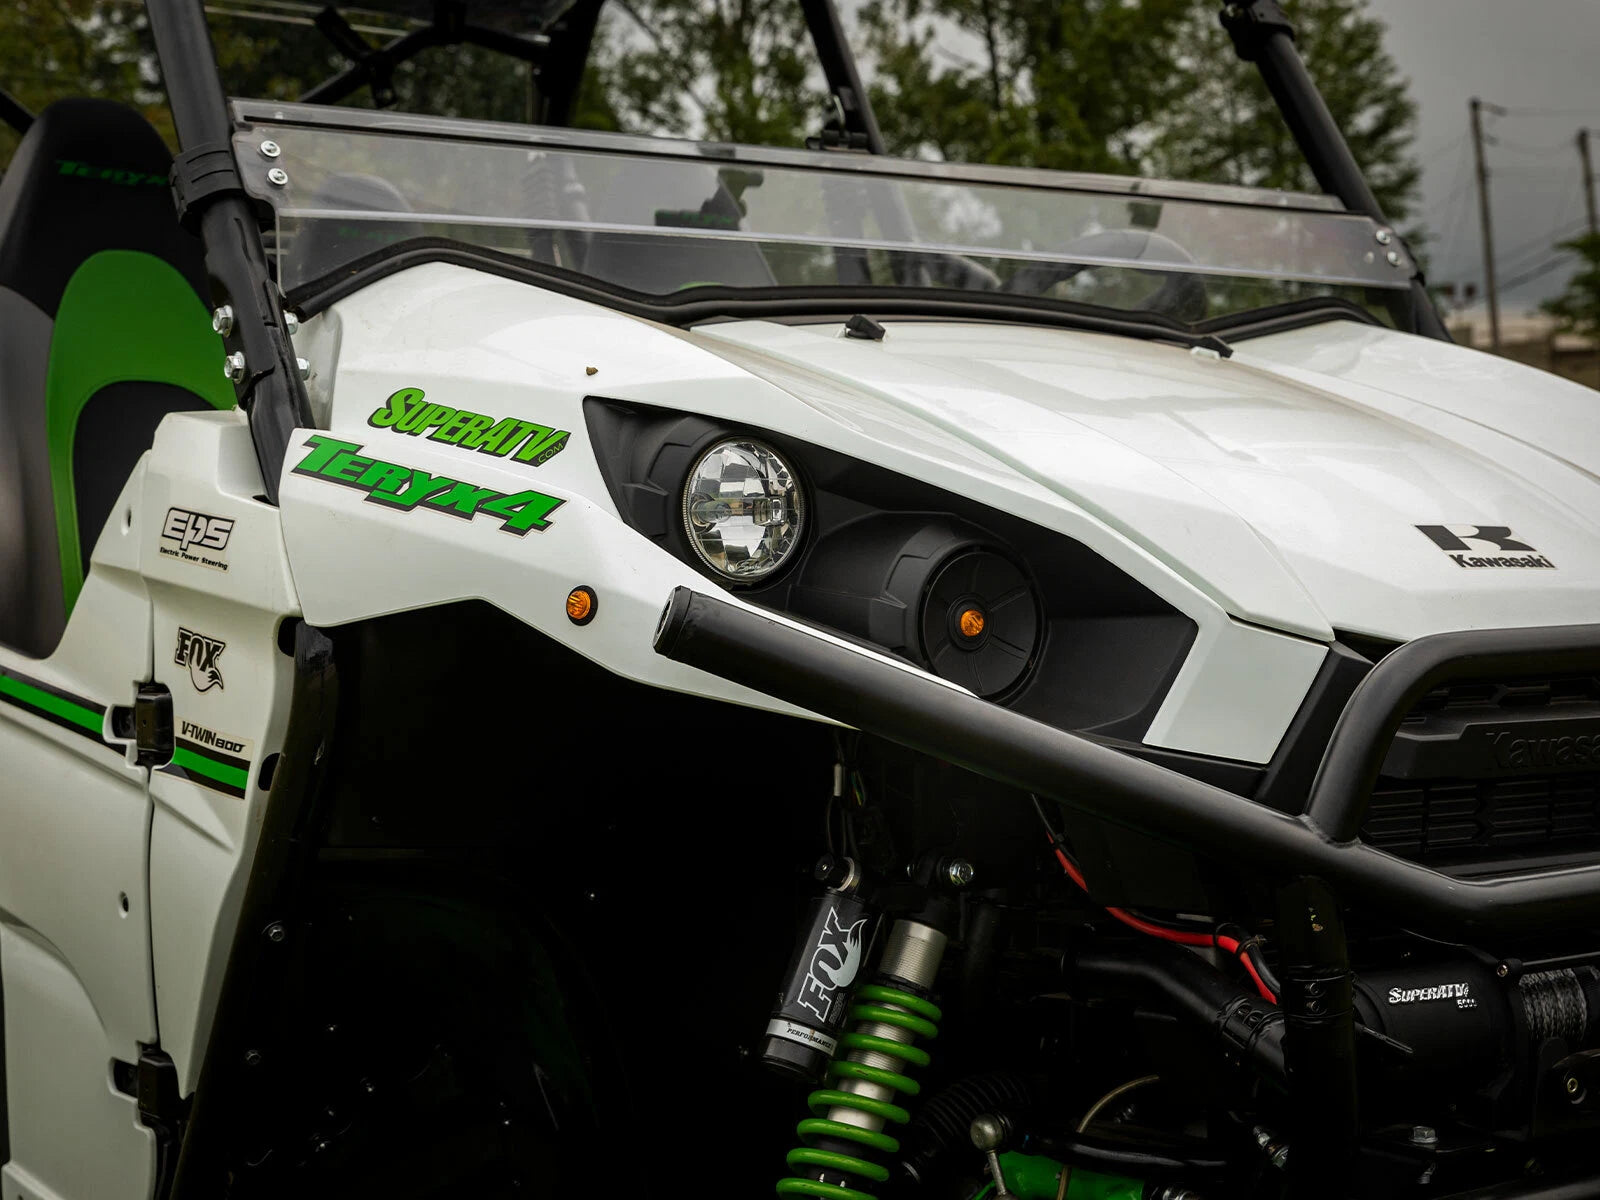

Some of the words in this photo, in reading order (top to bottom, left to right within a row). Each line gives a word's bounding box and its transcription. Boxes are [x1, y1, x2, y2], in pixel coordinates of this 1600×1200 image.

[367, 387, 571, 467] SUPERATV
[291, 434, 567, 537] TERYX4
[162, 507, 235, 551] EPS
[160, 547, 179, 557] Electric
[181, 552, 200, 562] Power
[201, 557, 229, 571] Steering
[1448, 554, 1556, 568] Kawasaki
[174, 627, 226, 674] FOX
[181, 720, 217, 746] V-TWIN
[215, 738, 246, 753] 800
[797, 906, 852, 1023] FOX
[1388, 982, 1470, 1004] SUPERATV
